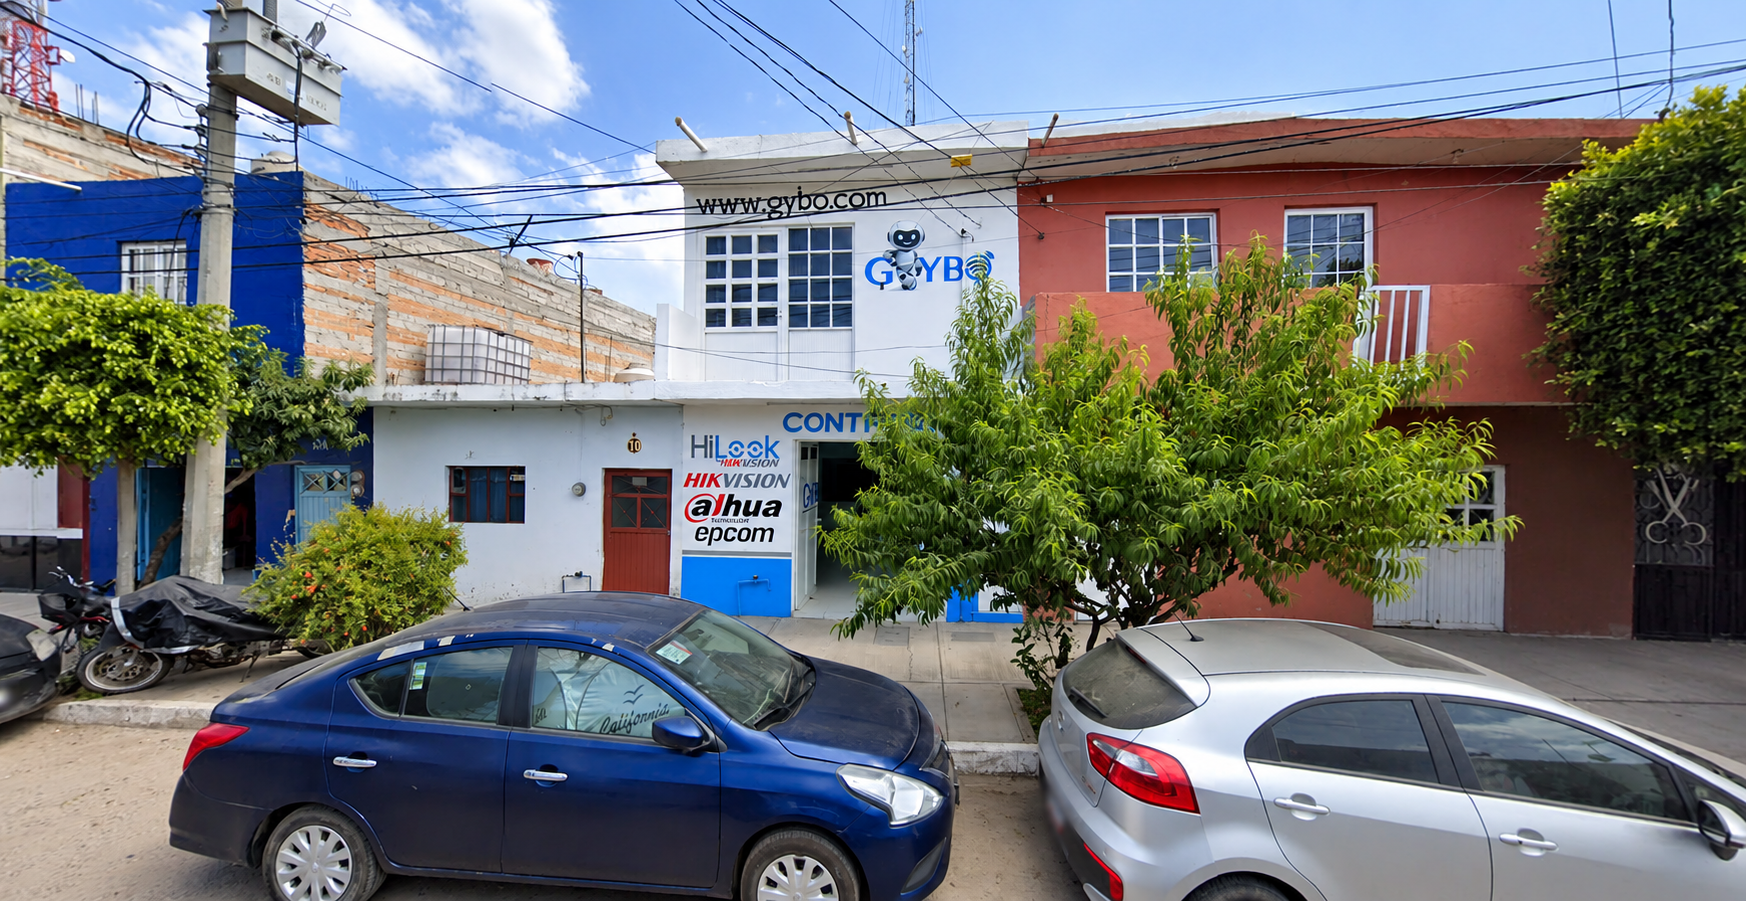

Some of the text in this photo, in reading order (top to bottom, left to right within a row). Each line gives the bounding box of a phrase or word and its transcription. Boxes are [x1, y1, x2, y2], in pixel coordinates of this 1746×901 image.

[696, 186, 887, 219] www.gybo.com
[629, 440, 641, 451] 10
[691, 434, 780, 460] HiLook
[683, 472, 791, 488] HIKVISION
[695, 526, 774, 546] epcom
